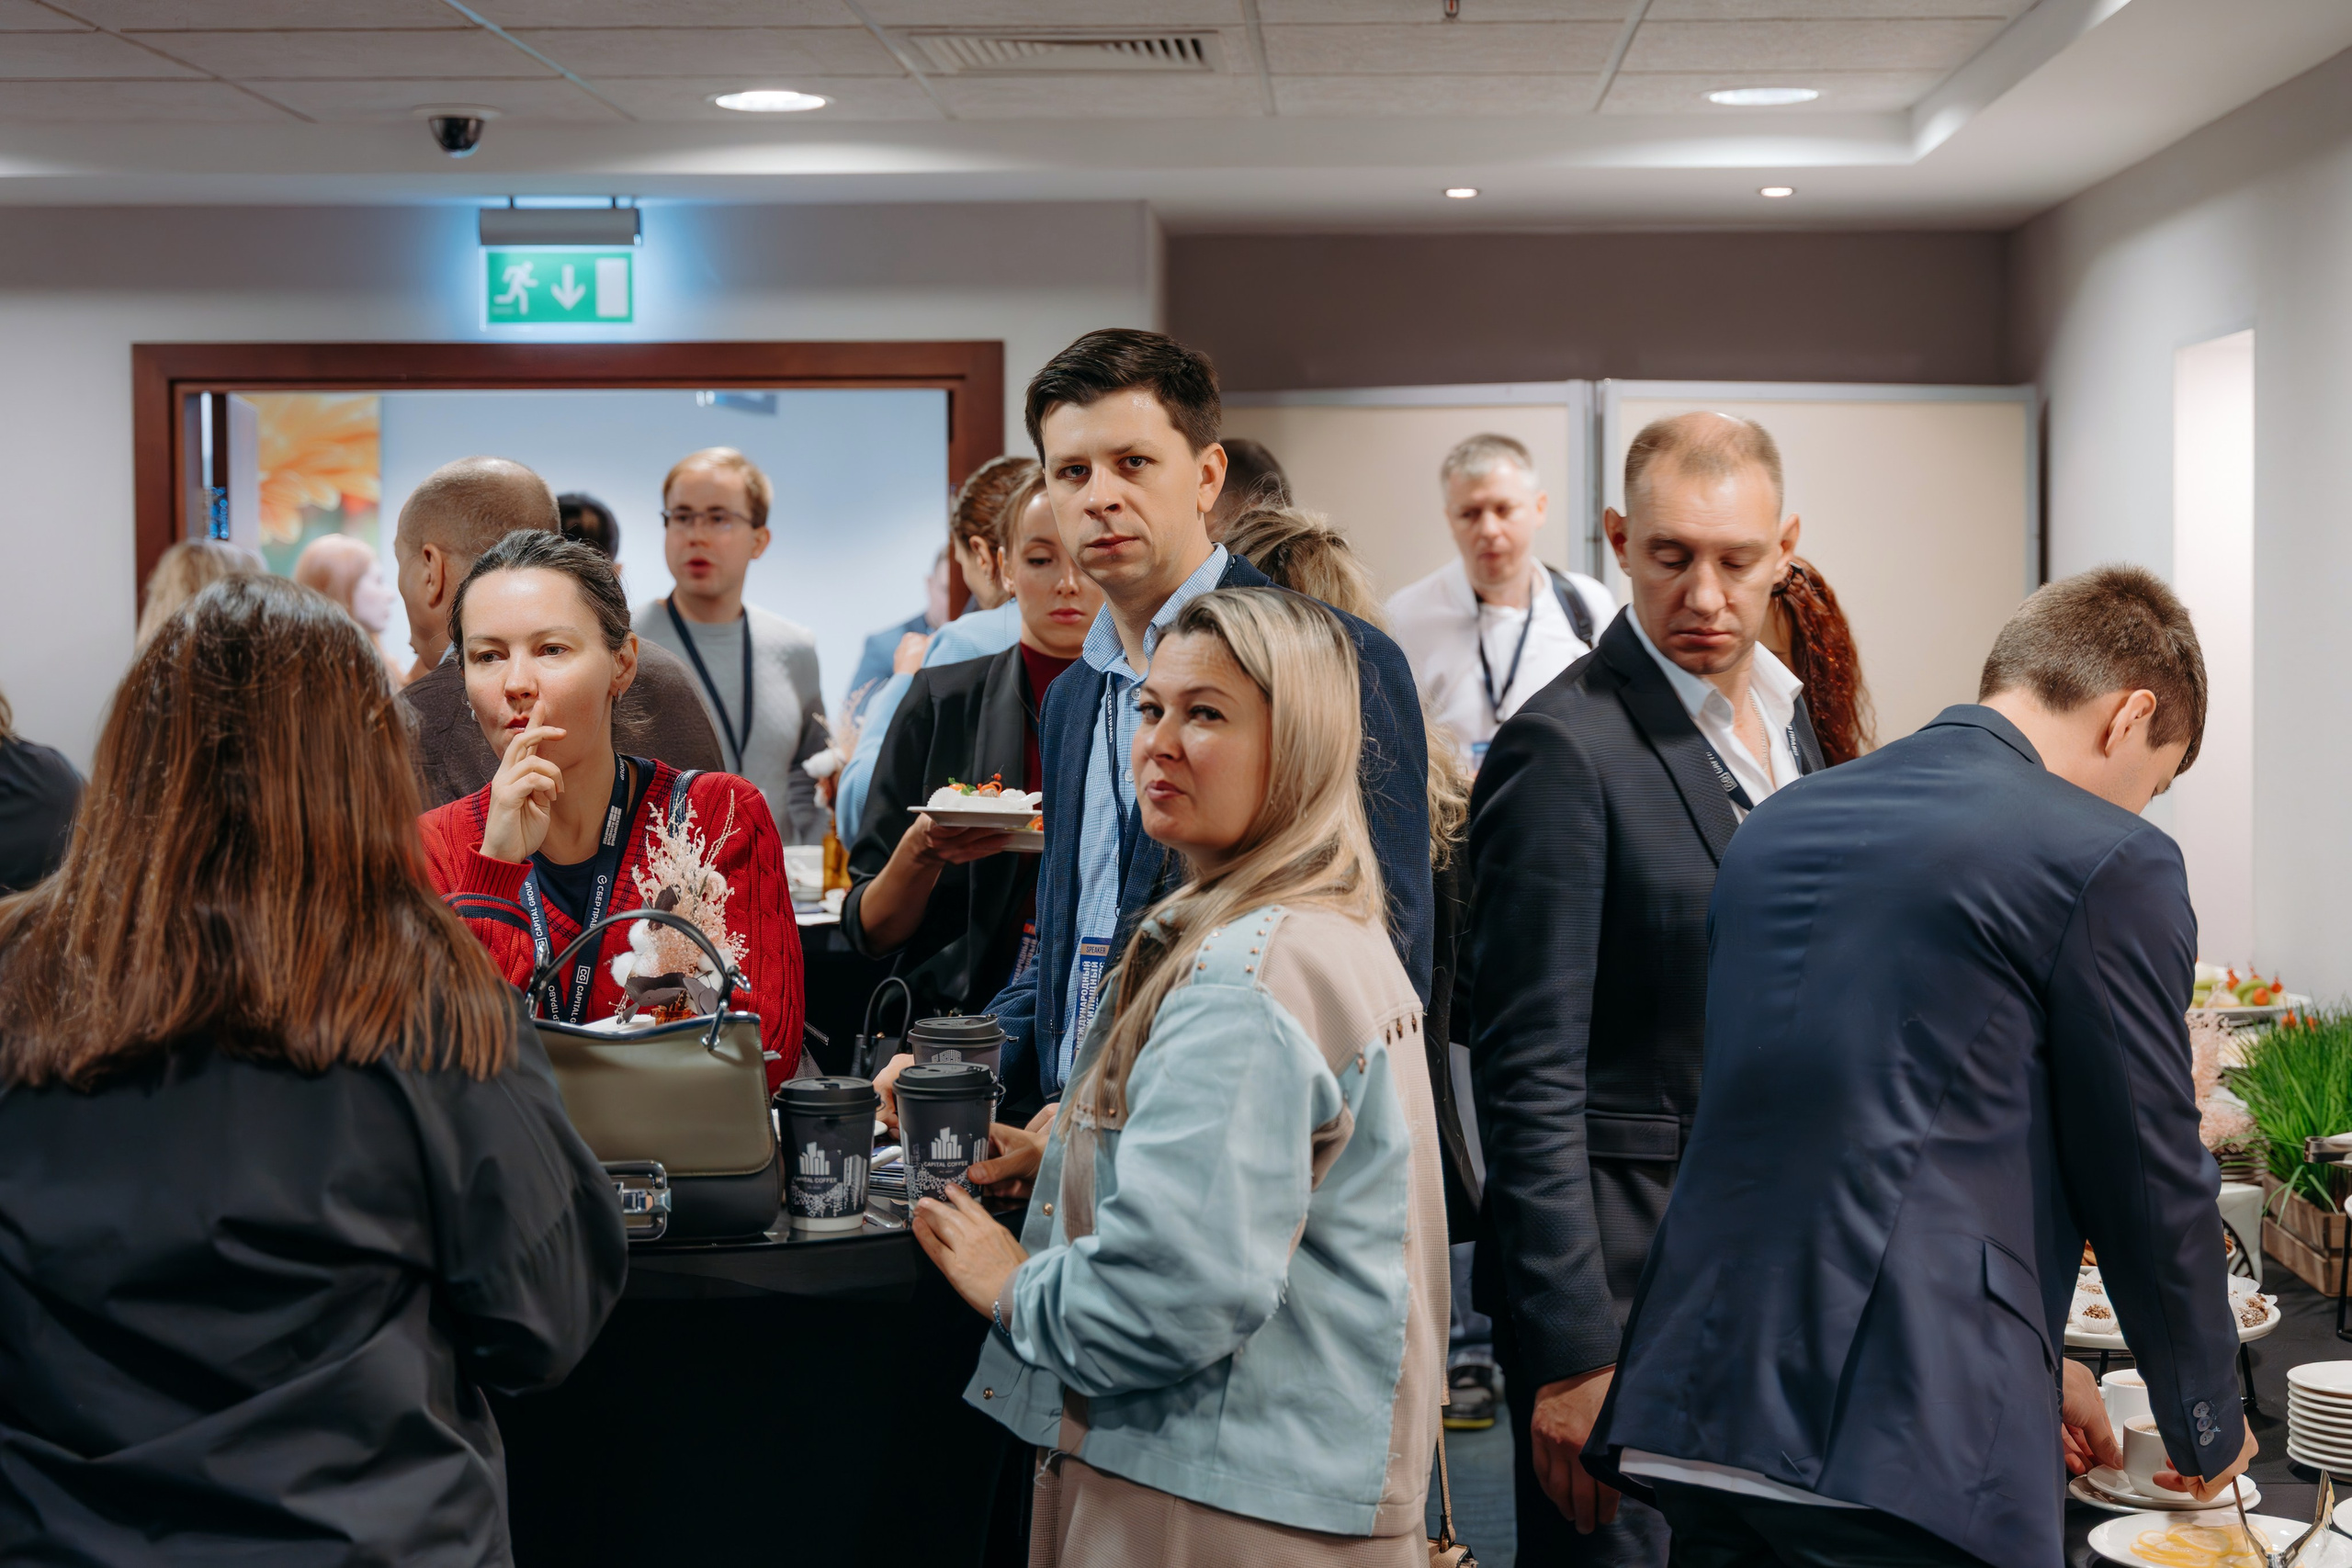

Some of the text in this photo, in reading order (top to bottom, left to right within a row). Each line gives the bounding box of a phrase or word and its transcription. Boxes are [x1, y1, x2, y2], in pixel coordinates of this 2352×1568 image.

[524, 881, 537, 907] GROUP
[589, 886, 605, 929] СБЕР ПРАВ
[530, 907, 544, 937] CAPITAL
[1085, 945, 1106, 954] SPEAKER
[548, 985, 560, 1013] ПРАВО
[571, 985, 584, 1017] CAPITAL
